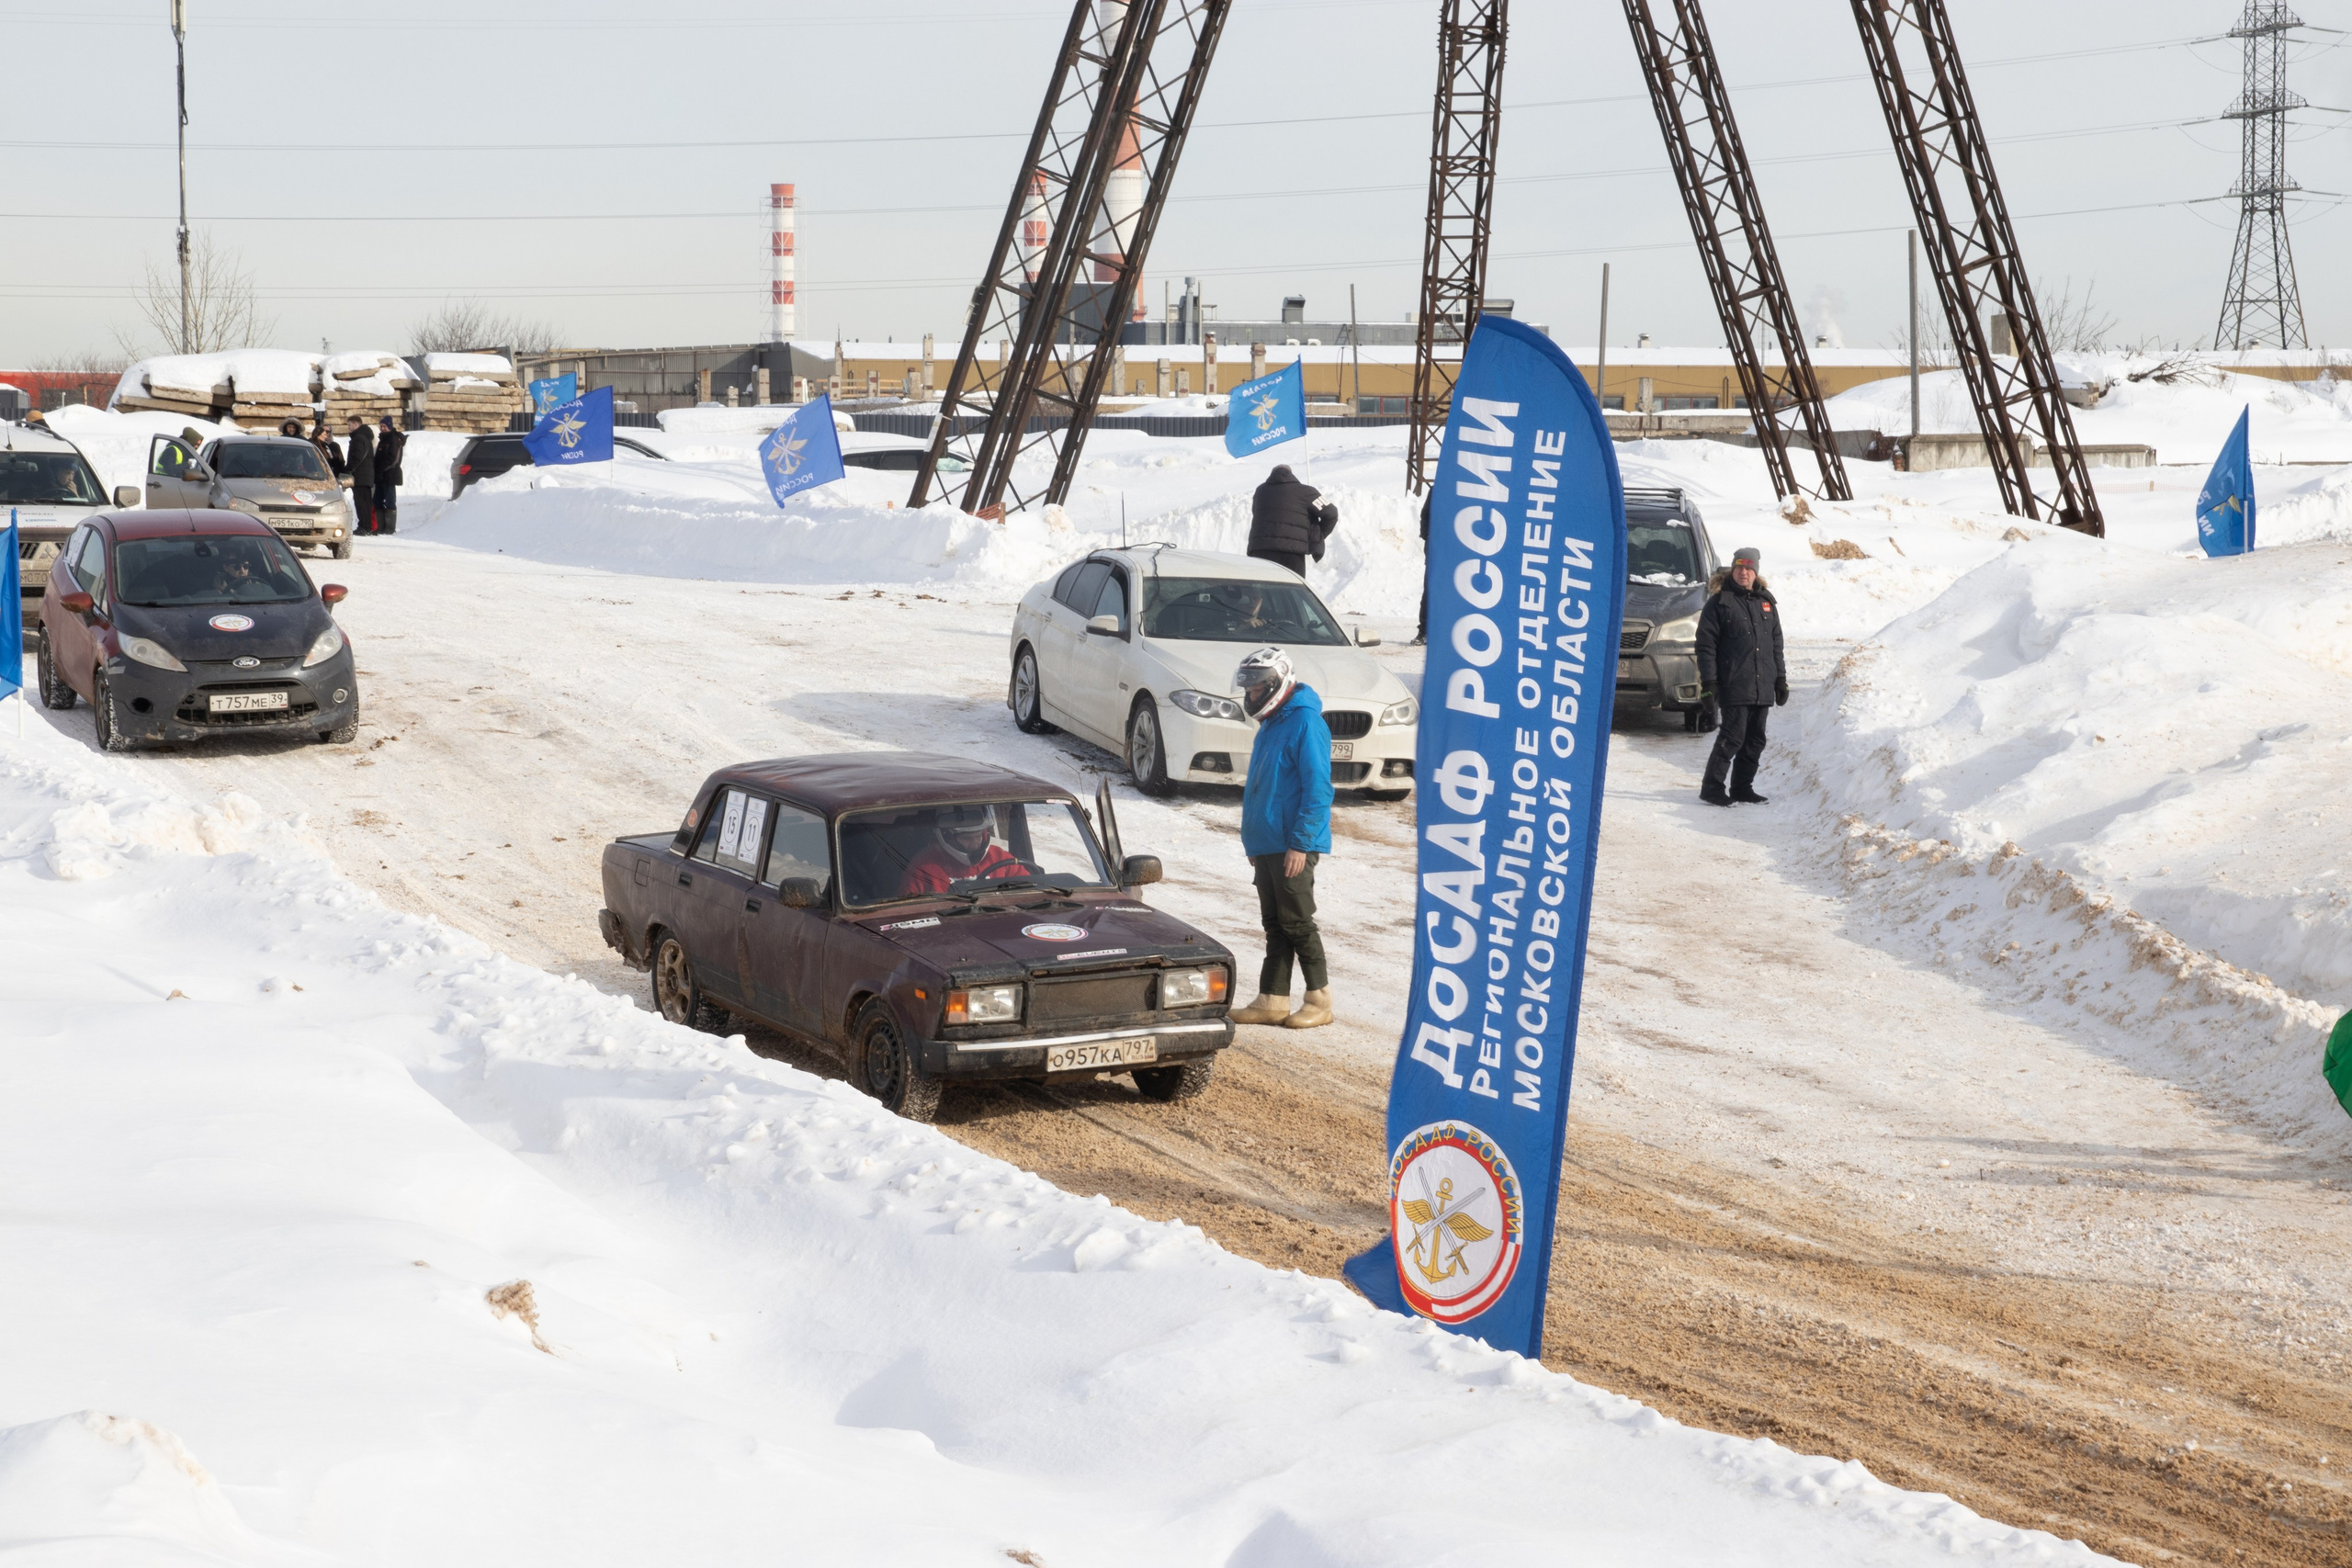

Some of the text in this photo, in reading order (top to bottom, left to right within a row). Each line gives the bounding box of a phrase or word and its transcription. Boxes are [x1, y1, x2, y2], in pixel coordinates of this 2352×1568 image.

[271, 694, 283, 703] 39
[1332, 745, 1350, 753] 799
[1410, 396, 1520, 1089] ДОСААФ РОССИИ
[1469, 429, 1566, 1100] РЕГИОНАЛЬНОЕ ОТДЕЛЕНИЕ
[727, 816, 737, 834] 15
[747, 823, 756, 842] 11
[1512, 536, 1594, 1112] МОСКОВСКОЙ ОБЛАСТИ
[1125, 1040, 1150, 1055] 797
[1390, 1123, 1521, 1234] ДОСААФ РОССИИ
